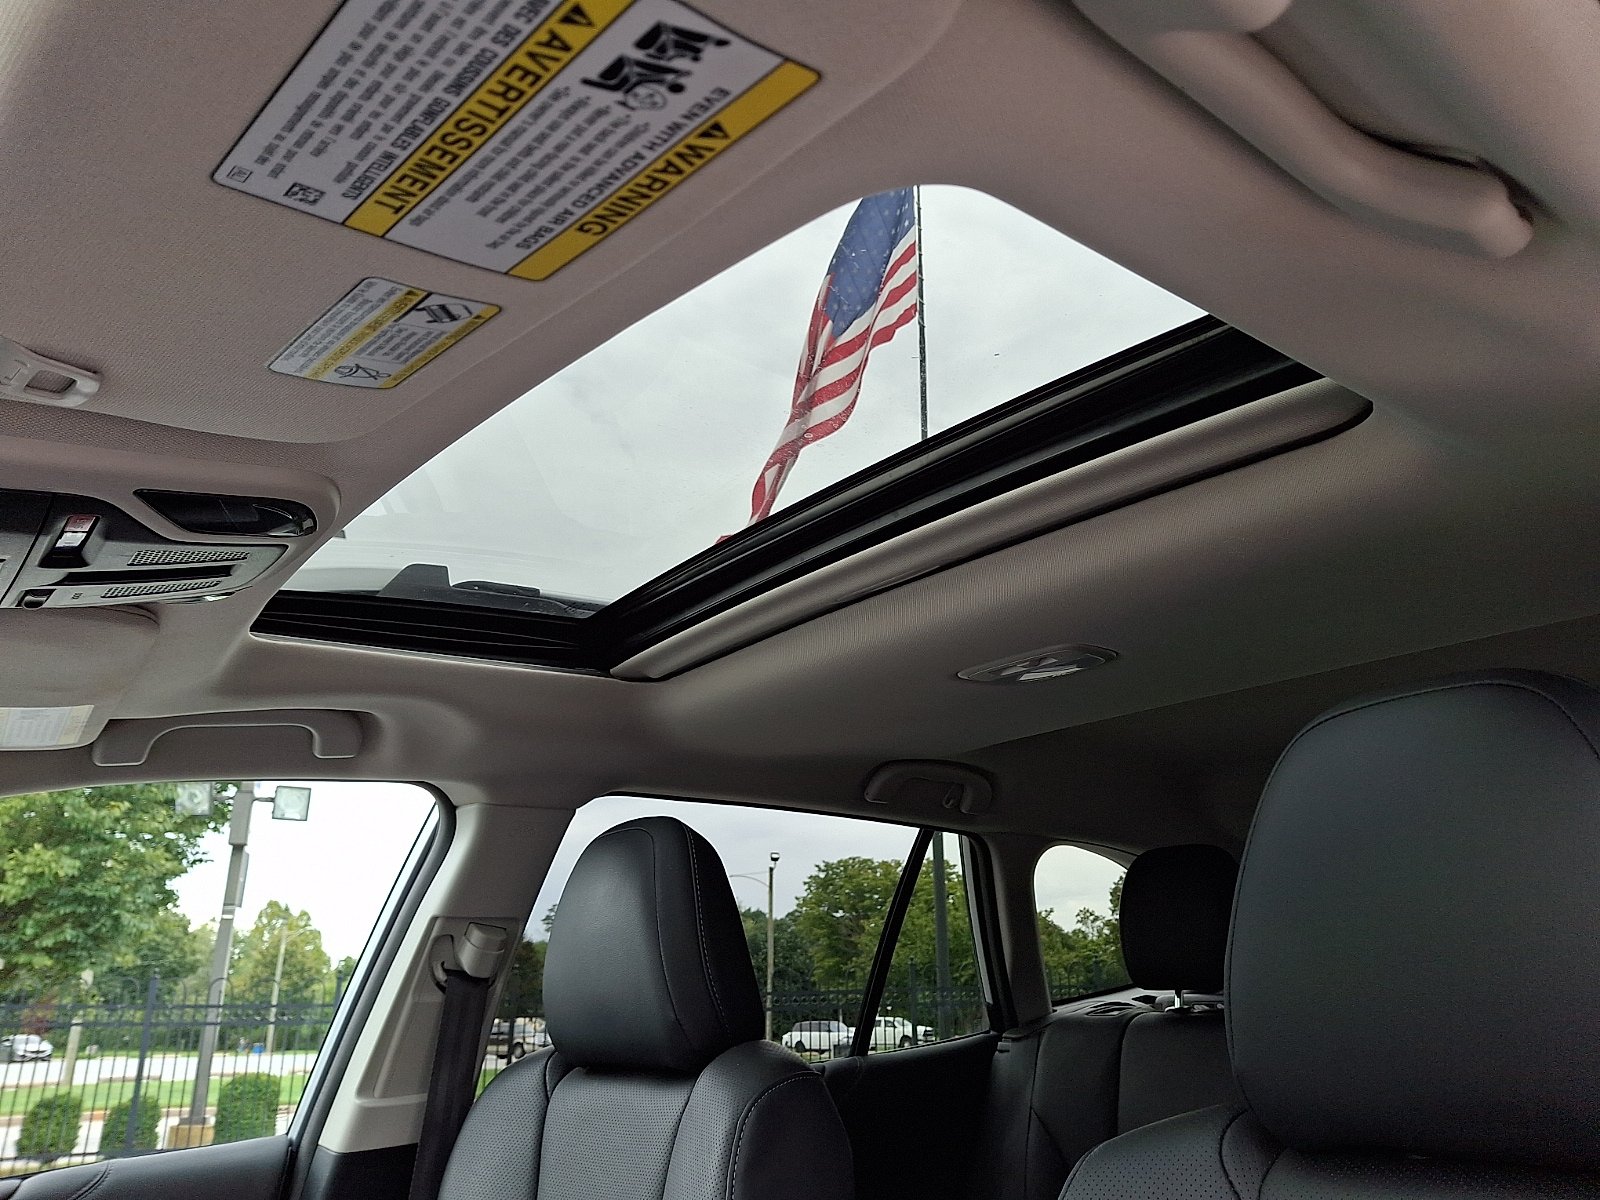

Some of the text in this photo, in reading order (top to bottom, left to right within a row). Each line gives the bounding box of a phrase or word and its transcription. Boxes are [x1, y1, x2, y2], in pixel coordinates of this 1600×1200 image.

[490, 23, 523, 48] DES
[442, 47, 499, 98] COUSSINS
[374, 28, 573, 215] AVERTISSEMENT
[390, 96, 452, 152] GONFLABLES
[341, 150, 400, 201] INTELLIGENTS
[515, 87, 731, 250] EVEN WITH ADVANCED AIR BAGS
[576, 143, 715, 236] WARNING
